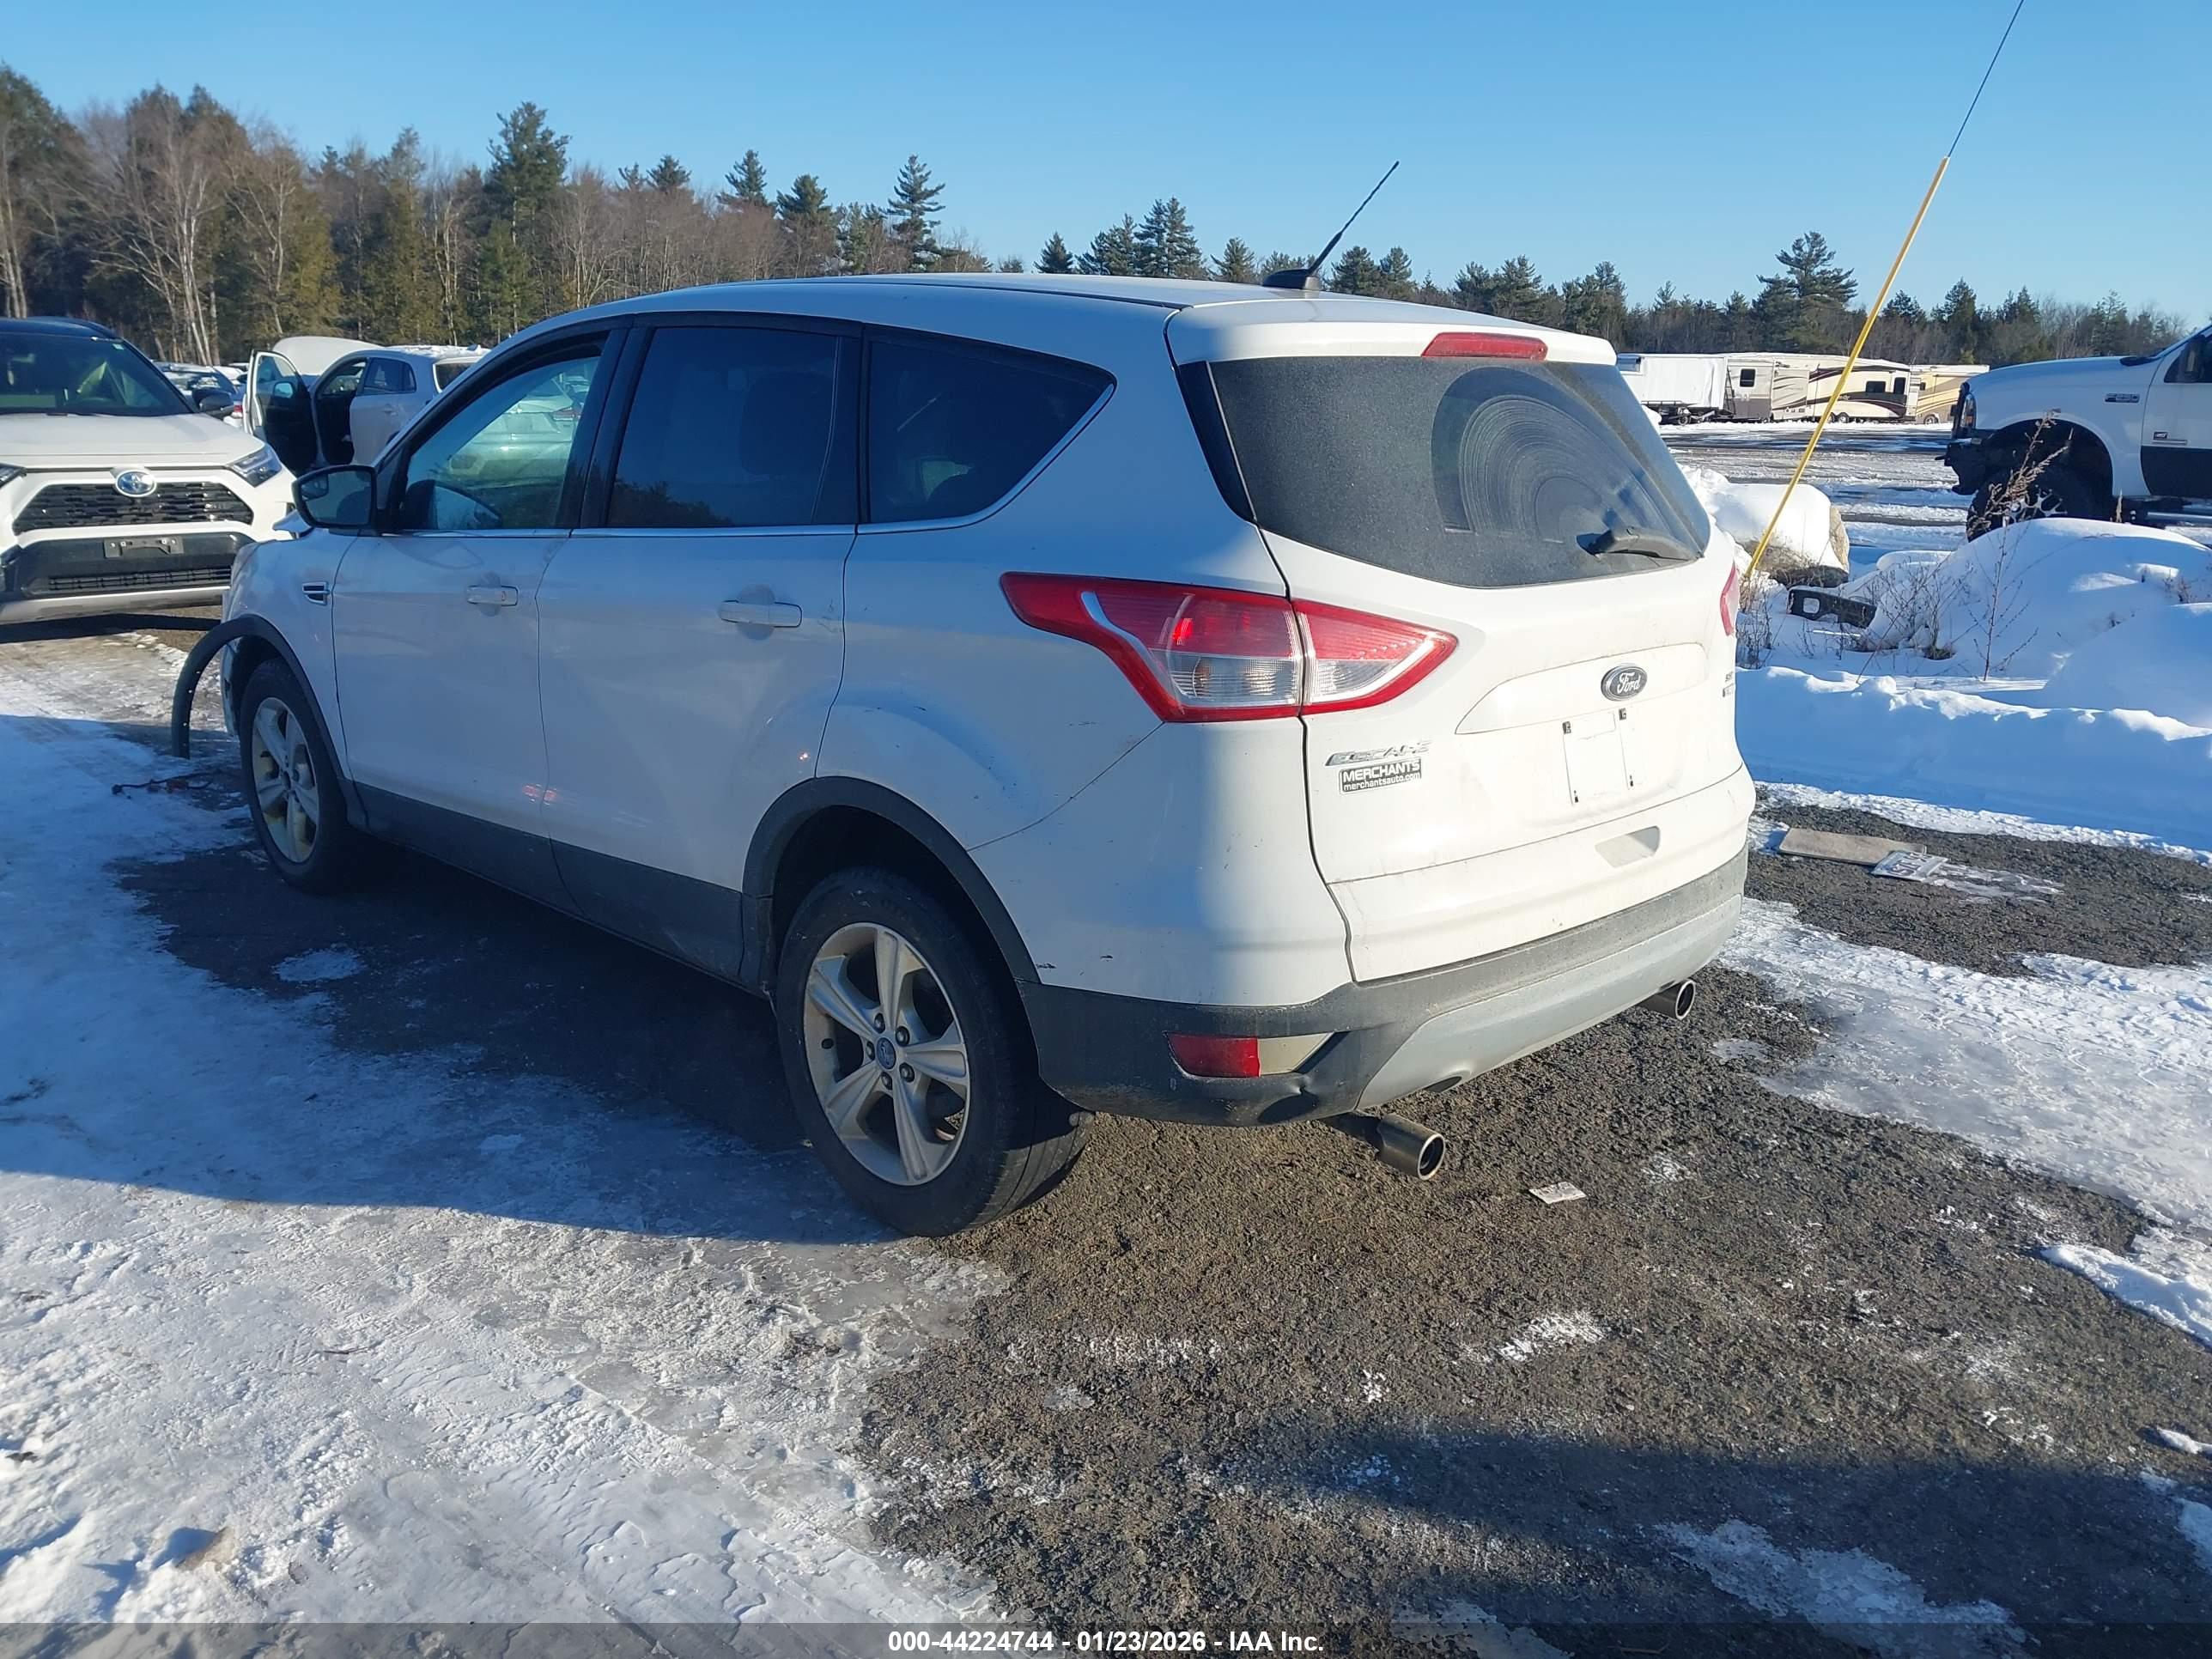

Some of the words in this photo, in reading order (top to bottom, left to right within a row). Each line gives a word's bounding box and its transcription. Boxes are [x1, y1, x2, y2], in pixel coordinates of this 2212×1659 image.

[1617, 672, 1641, 694] Ford
[1343, 759, 1420, 782] MERCHANTS
[1344, 772, 1420, 791] merchantsauto.com
